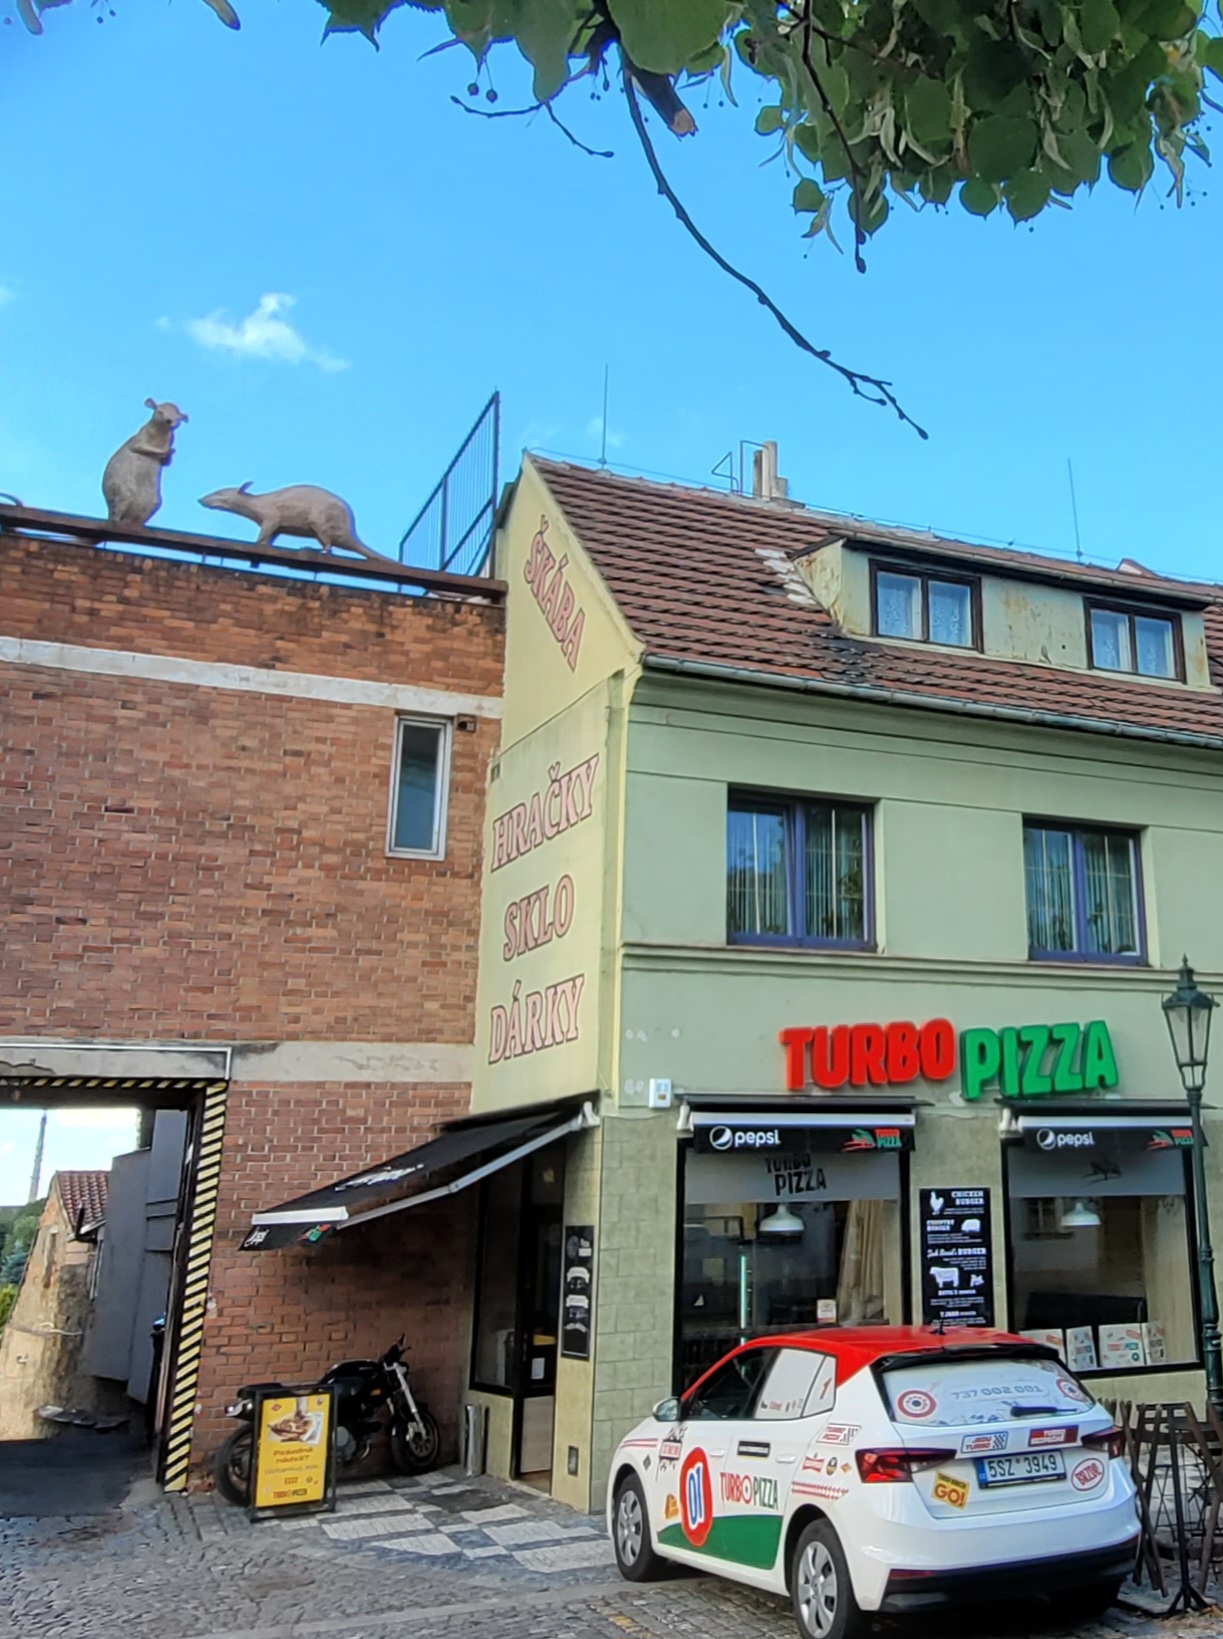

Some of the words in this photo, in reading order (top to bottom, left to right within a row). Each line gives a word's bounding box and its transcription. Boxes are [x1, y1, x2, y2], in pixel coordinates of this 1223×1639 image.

[523, 514, 585, 673] ŠKÁBA
[491, 752, 599, 873] HRAČKY
[503, 874, 575, 962] SKLO
[488, 973, 585, 1065] DÁRKY
[780, 1018, 956, 1091] TURBO
[960, 1020, 1119, 1100] PIZZA
[734, 1129, 781, 1148] pepsi
[1056, 1131, 1095, 1148] pepsi
[774, 1168, 827, 1197] PIZZA
[951, 1389, 977, 1399] 737
[981, 1386, 1012, 1397] 002
[1016, 1384, 1044, 1394] 001
[987, 1457, 1016, 1478] 5SZ
[1024, 1454, 1057, 1474] 3949
[687, 1464, 704, 1528] 01
[720, 1472, 753, 1504] TURBO
[753, 1476, 778, 1510] PIZZA
[934, 1482, 966, 1508] GO!
